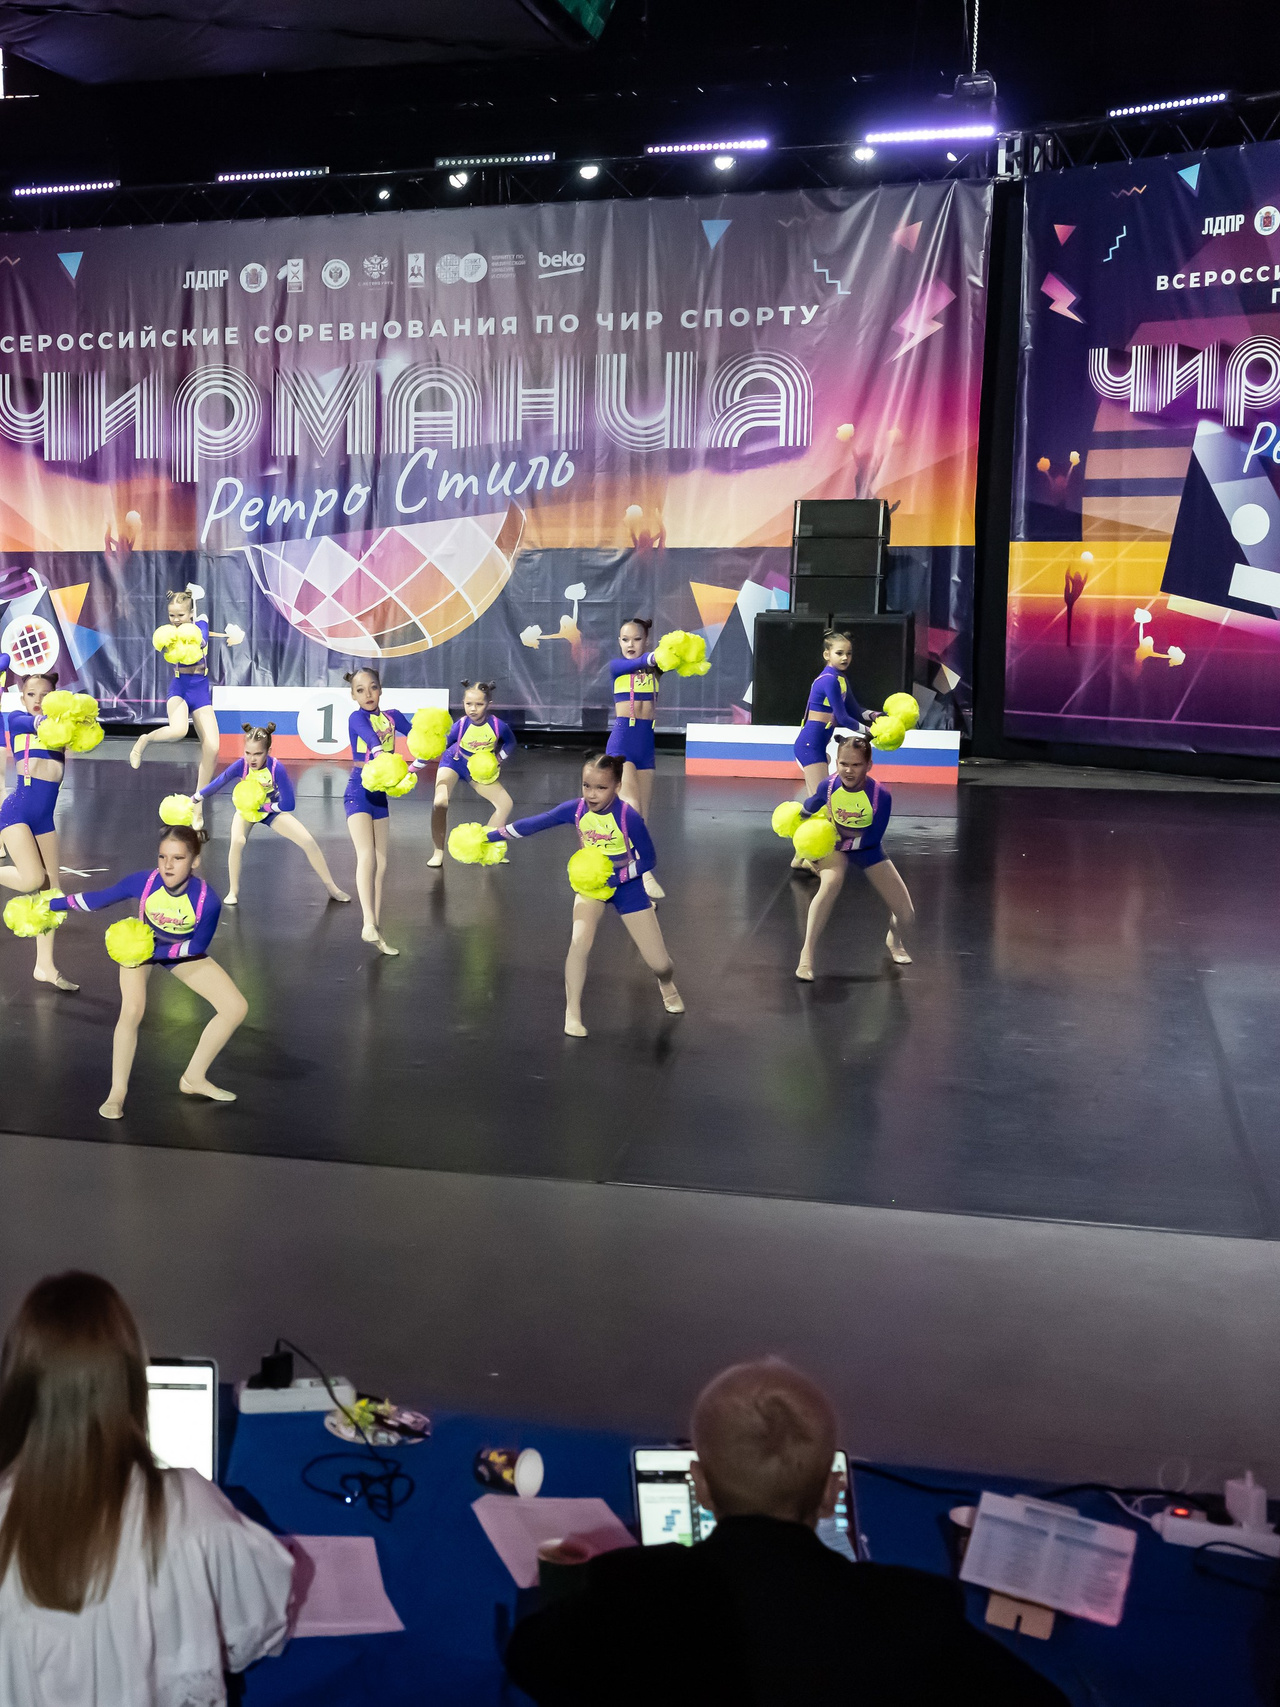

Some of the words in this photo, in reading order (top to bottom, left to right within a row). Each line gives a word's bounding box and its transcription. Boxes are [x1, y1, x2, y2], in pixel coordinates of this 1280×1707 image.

[1201, 214, 1245, 237] ЛДПР
[538, 250, 586, 268] beko
[182, 269, 229, 291] ЛДПР
[254, 316, 517, 345] СОРЕВНОВАНИЯ
[535, 313, 580, 334] ПО
[596, 310, 663, 332] ЧИР
[680, 303, 820, 329] СПОРТУ
[200, 476, 372, 544] Ретро
[394, 447, 576, 515] Стиль
[317, 704, 338, 742] 1
